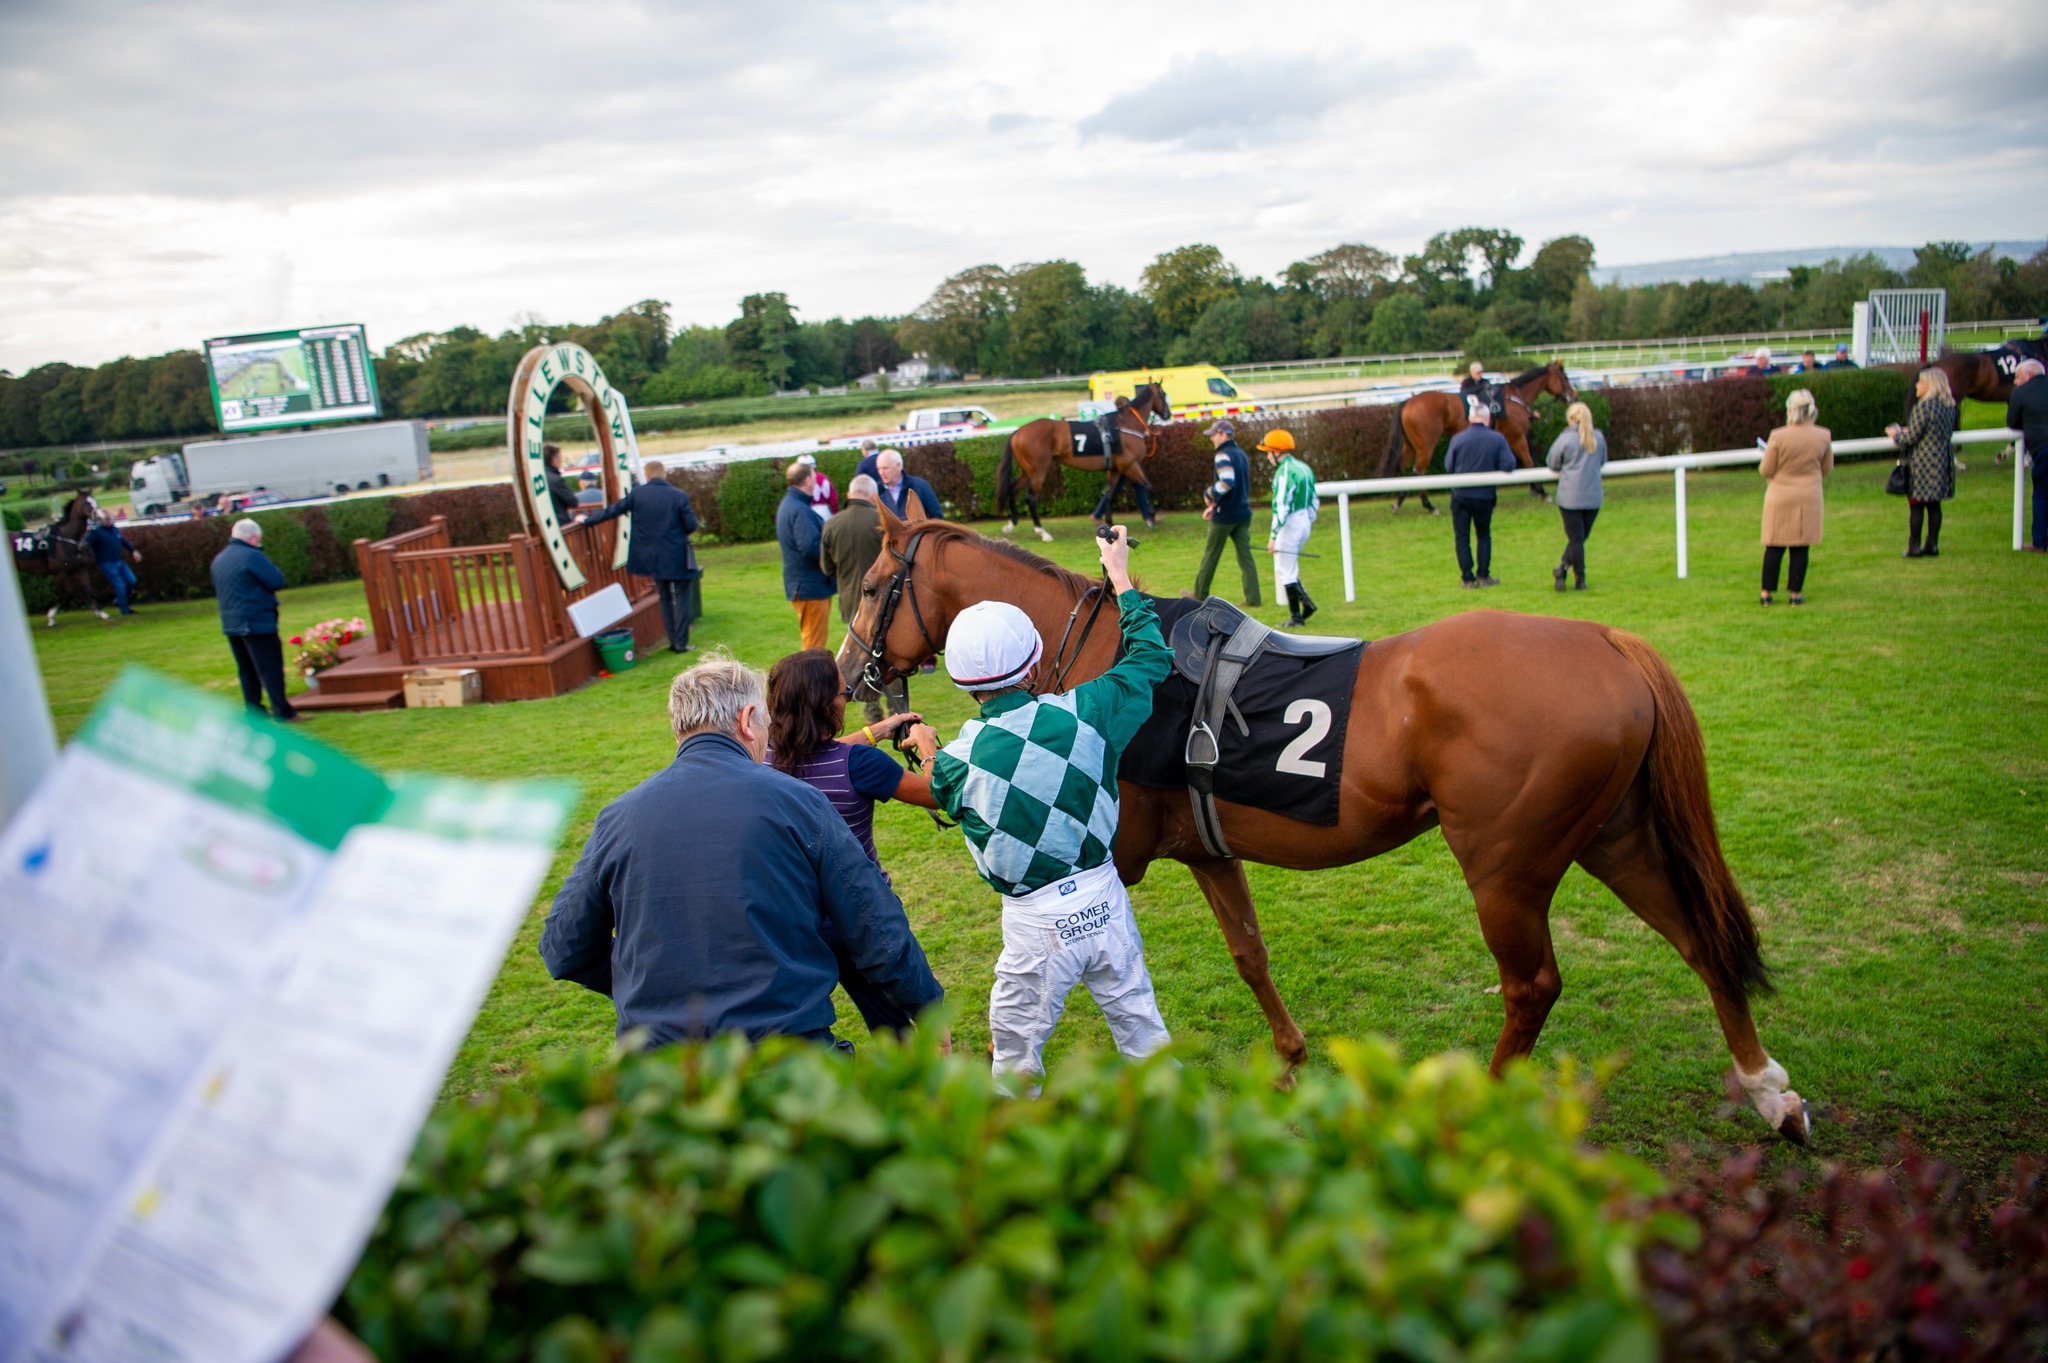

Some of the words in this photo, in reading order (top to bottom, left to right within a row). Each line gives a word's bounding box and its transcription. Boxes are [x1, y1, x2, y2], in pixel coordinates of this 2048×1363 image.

[1997, 355, 2017, 375] 12
[528, 347, 629, 496] BELLEWSTOWN
[1074, 434, 1088, 452] 7
[14, 536, 34, 551] 14
[1276, 698, 1332, 778] 2
[1055, 901, 1110, 929] COMER
[1060, 914, 1110, 940] GROUP
